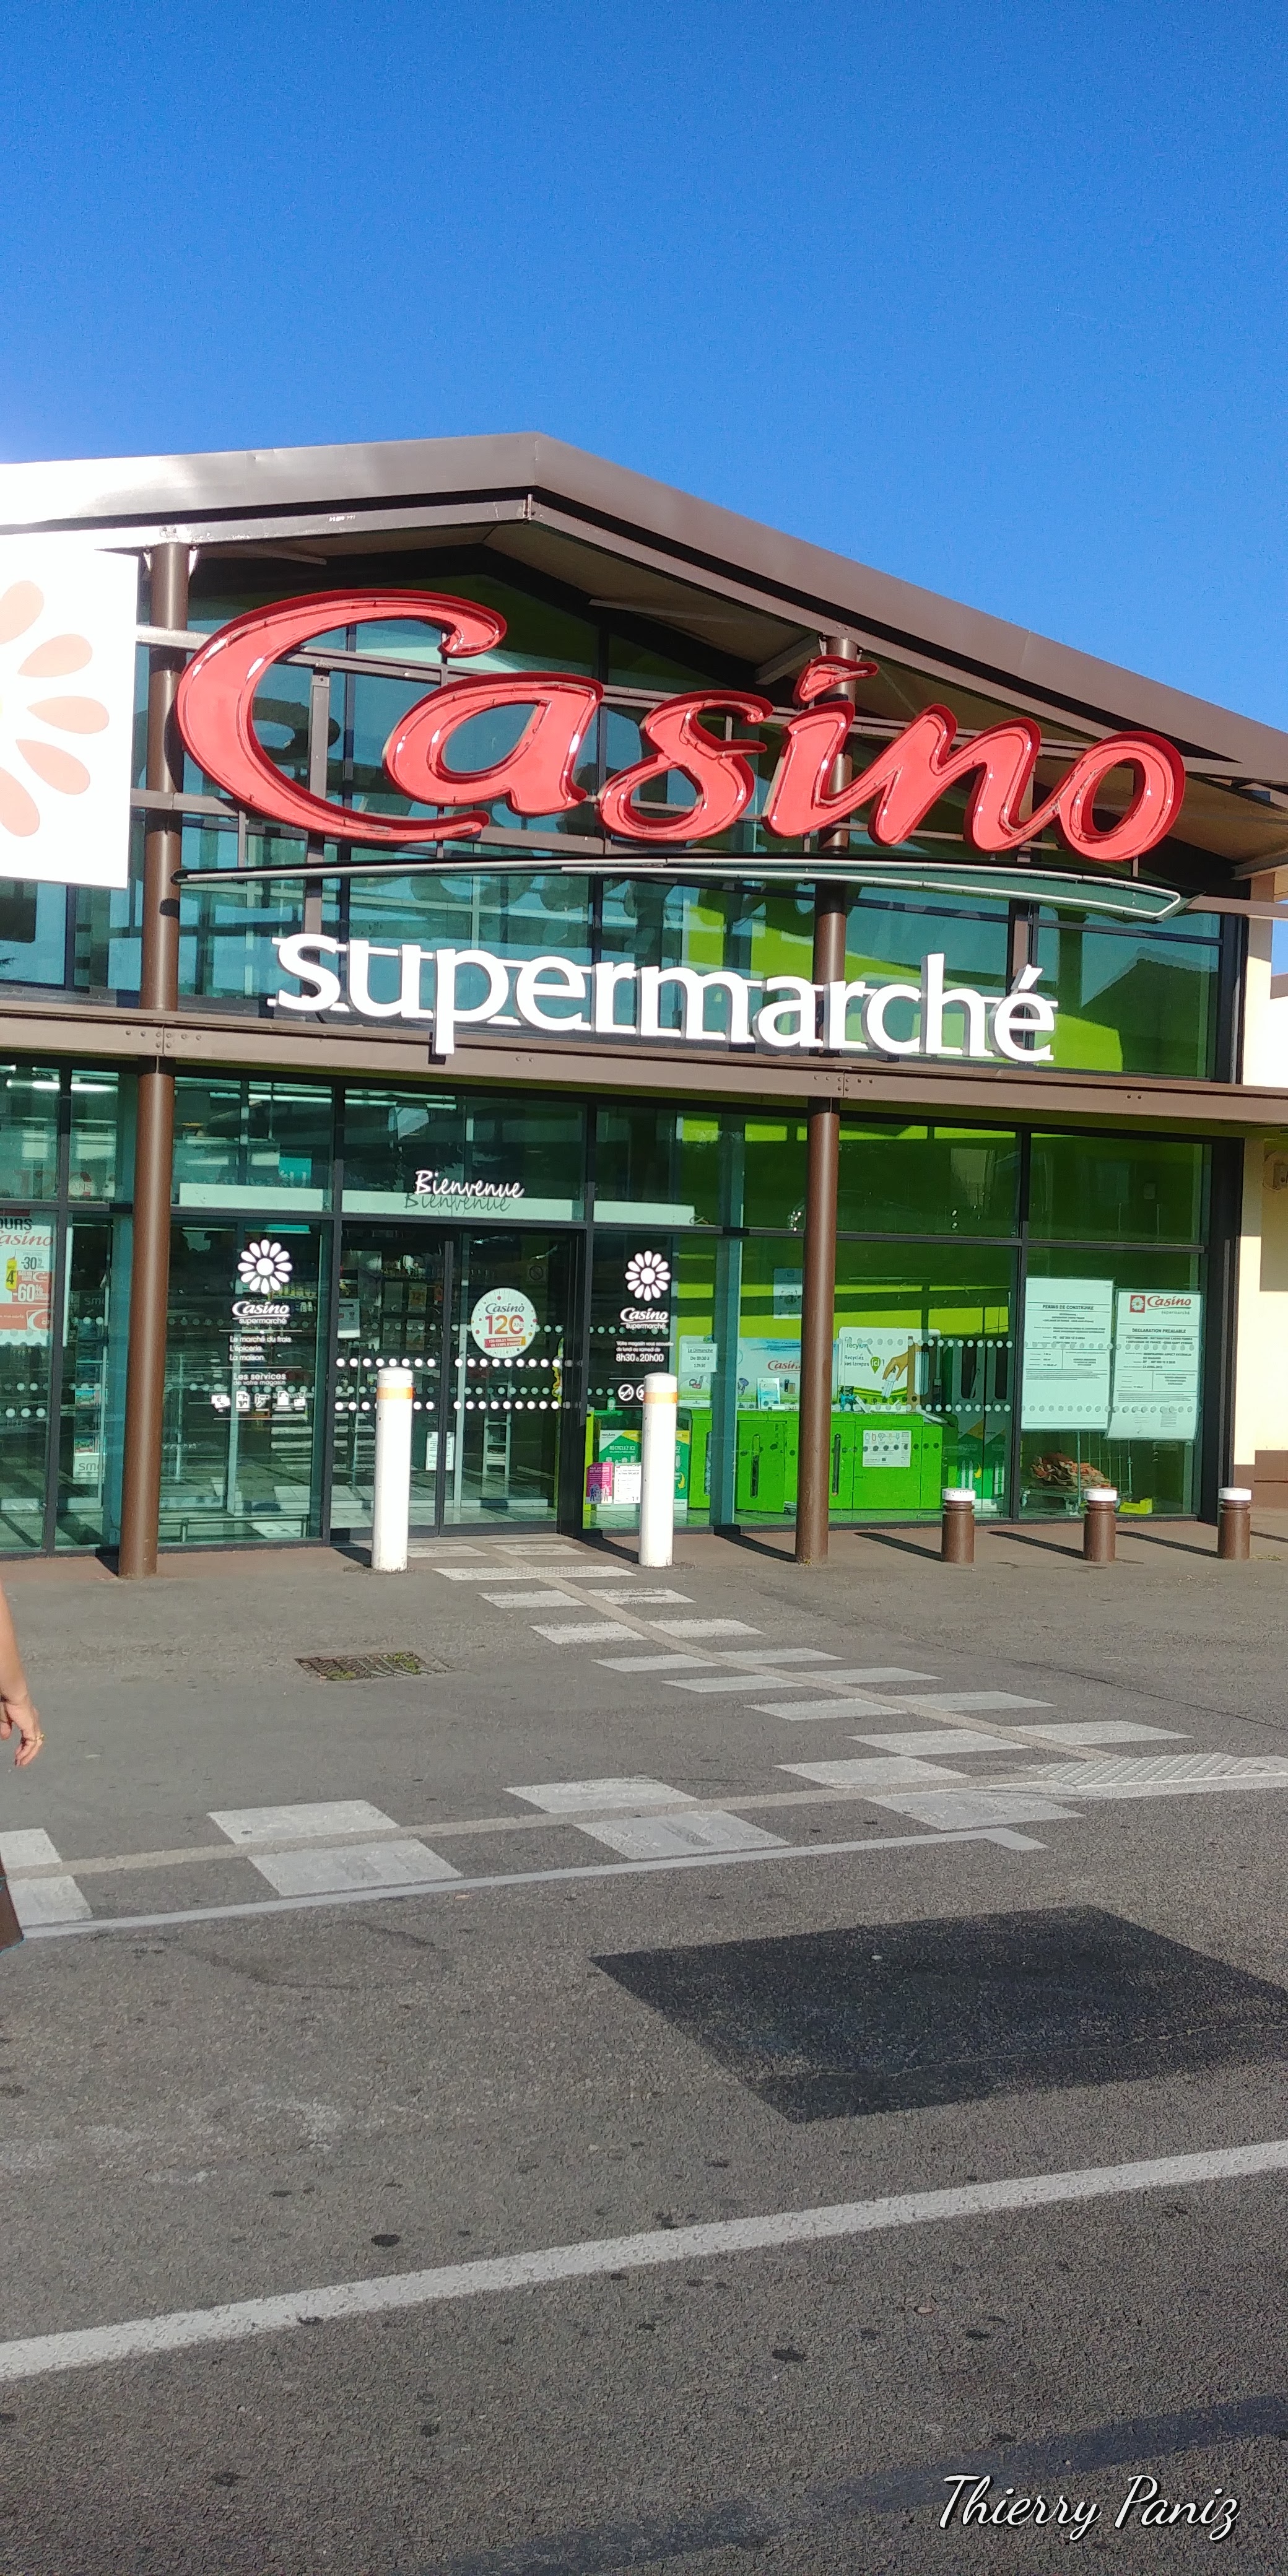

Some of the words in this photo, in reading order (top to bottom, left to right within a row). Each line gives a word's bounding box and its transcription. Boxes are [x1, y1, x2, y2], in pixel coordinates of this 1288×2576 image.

[176, 588, 1185, 861] Casino
[272, 933, 1056, 1063] supermarché
[414, 1169, 526, 1199] Bienvenue
[0, 1230, 54, 1247] asino
[232, 1301, 290, 1316] Casino
[485, 1303, 524, 1314] Casino
[1147, 1295, 1192, 1308] Casino
[620, 1307, 669, 1322] Casino
[616, 1353, 635, 1362] 8h30
[639, 1353, 664, 1362] 20h00
[233, 1372, 248, 1380] Les
[250, 1372, 287, 1380] services
